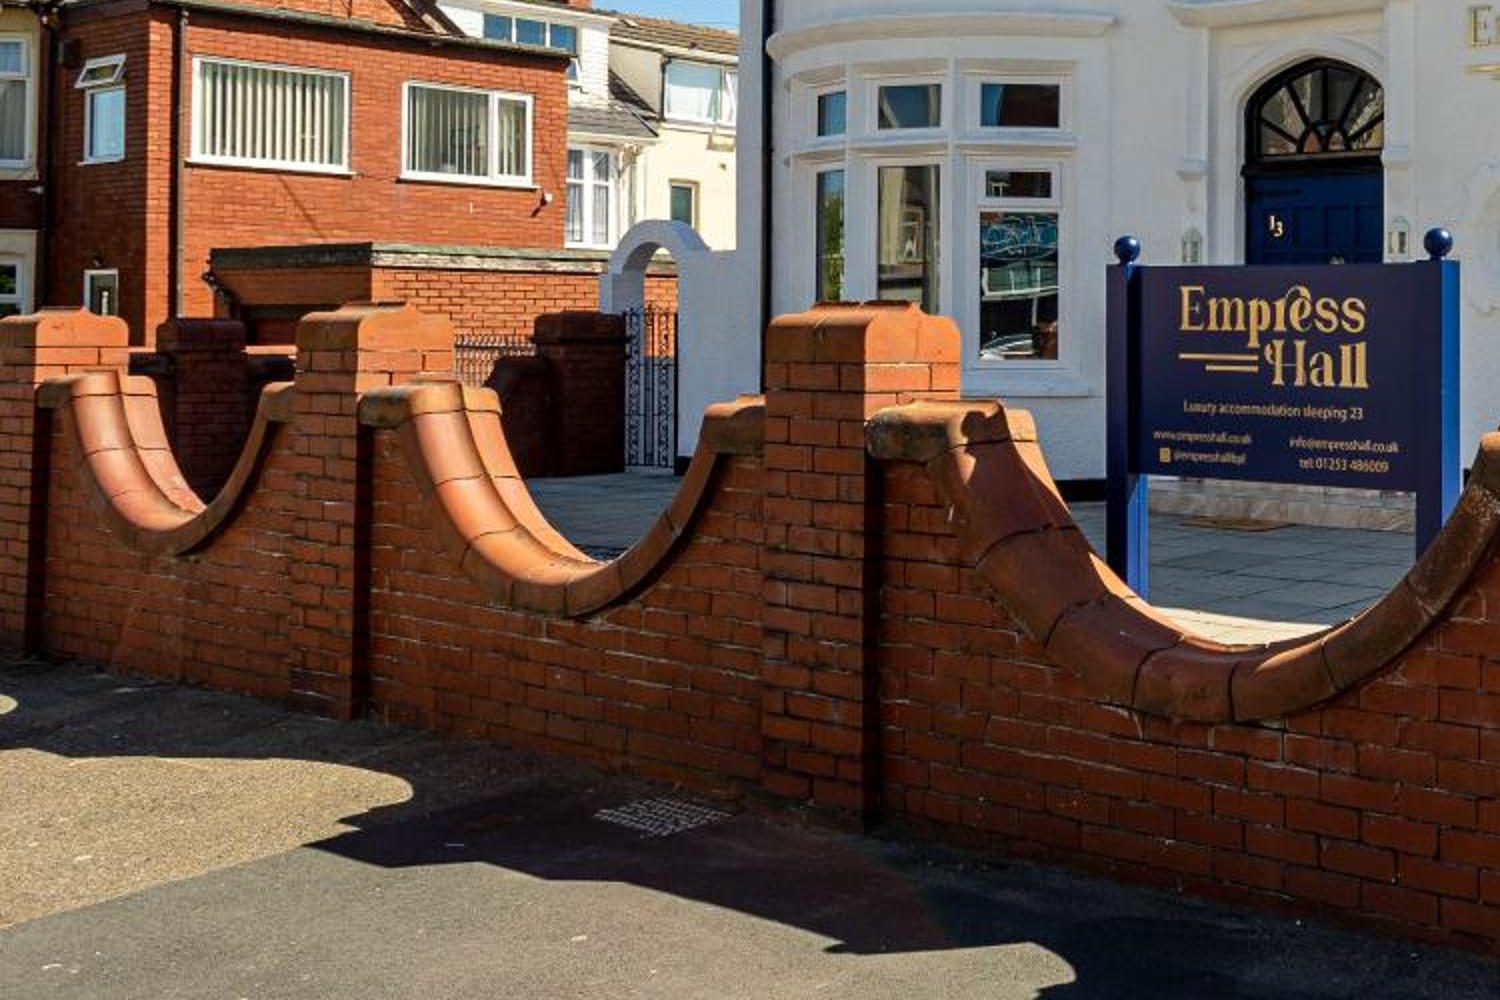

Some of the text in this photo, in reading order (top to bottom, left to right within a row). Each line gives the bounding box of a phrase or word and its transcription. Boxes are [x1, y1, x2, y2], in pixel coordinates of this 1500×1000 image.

[1178, 285, 1369, 348] Empress
[1264, 339, 1369, 389] Hall
[1183, 400, 1364, 422] Luxury accommodation sleeping 23
